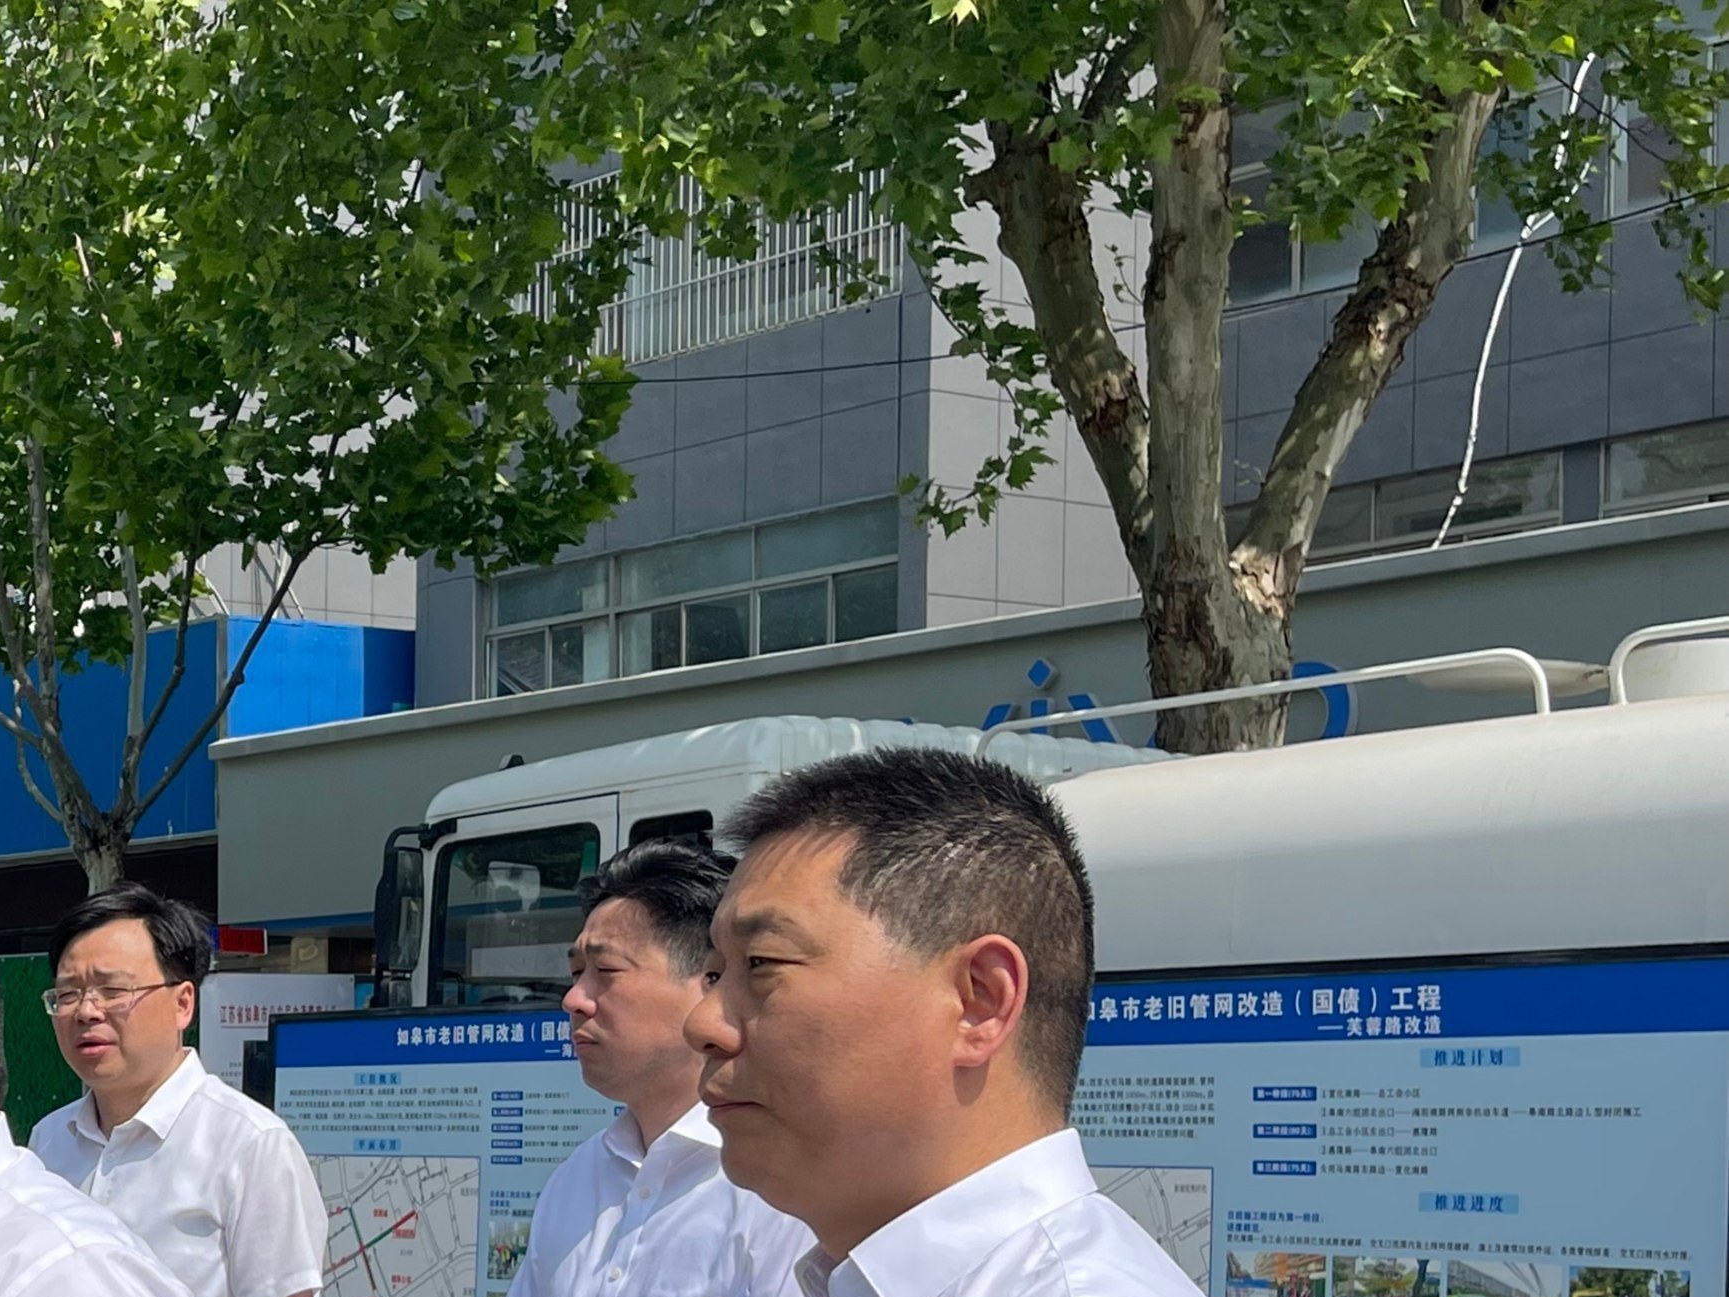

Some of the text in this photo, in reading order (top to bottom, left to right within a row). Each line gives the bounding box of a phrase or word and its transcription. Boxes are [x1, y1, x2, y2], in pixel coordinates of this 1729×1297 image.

[1433, 1048, 1505, 1067] 推进计划
[1434, 1194, 1505, 1213] 推进进度
